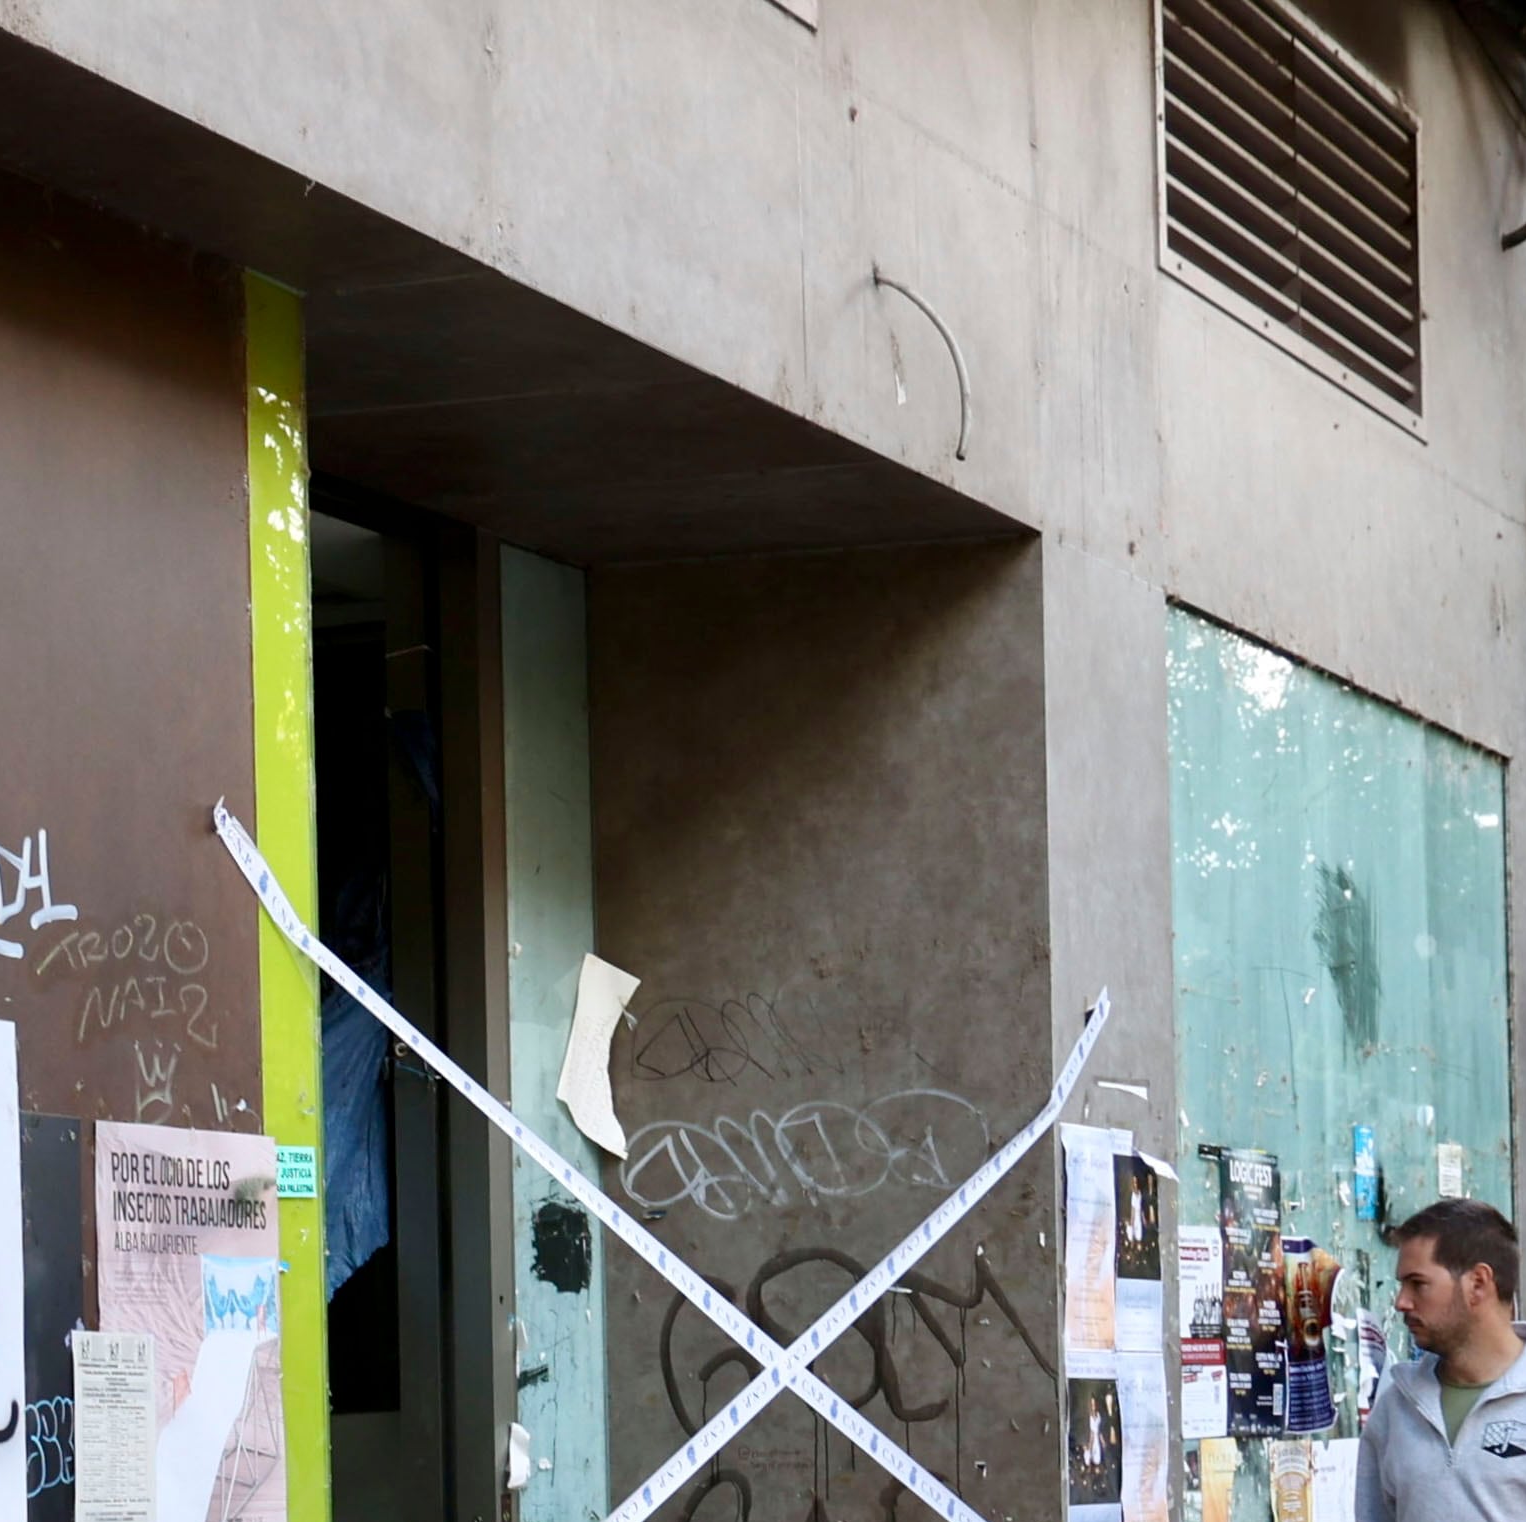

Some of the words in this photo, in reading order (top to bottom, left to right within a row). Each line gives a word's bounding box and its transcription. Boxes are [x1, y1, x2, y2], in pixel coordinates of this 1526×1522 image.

[288, 1152, 313, 1164] TIERRA
[111, 1152, 139, 1183] POR
[144, 1154, 157, 1184] EL
[160, 1156, 184, 1188] OCIO
[187, 1159, 203, 1189] DE
[207, 1160, 230, 1190] LOS
[280, 1167, 312, 1179] JUSTICIA
[113, 1191, 172, 1225] INSECTOS
[175, 1196, 267, 1230] TRABAJADORES
[115, 1231, 138, 1251] ALBA
